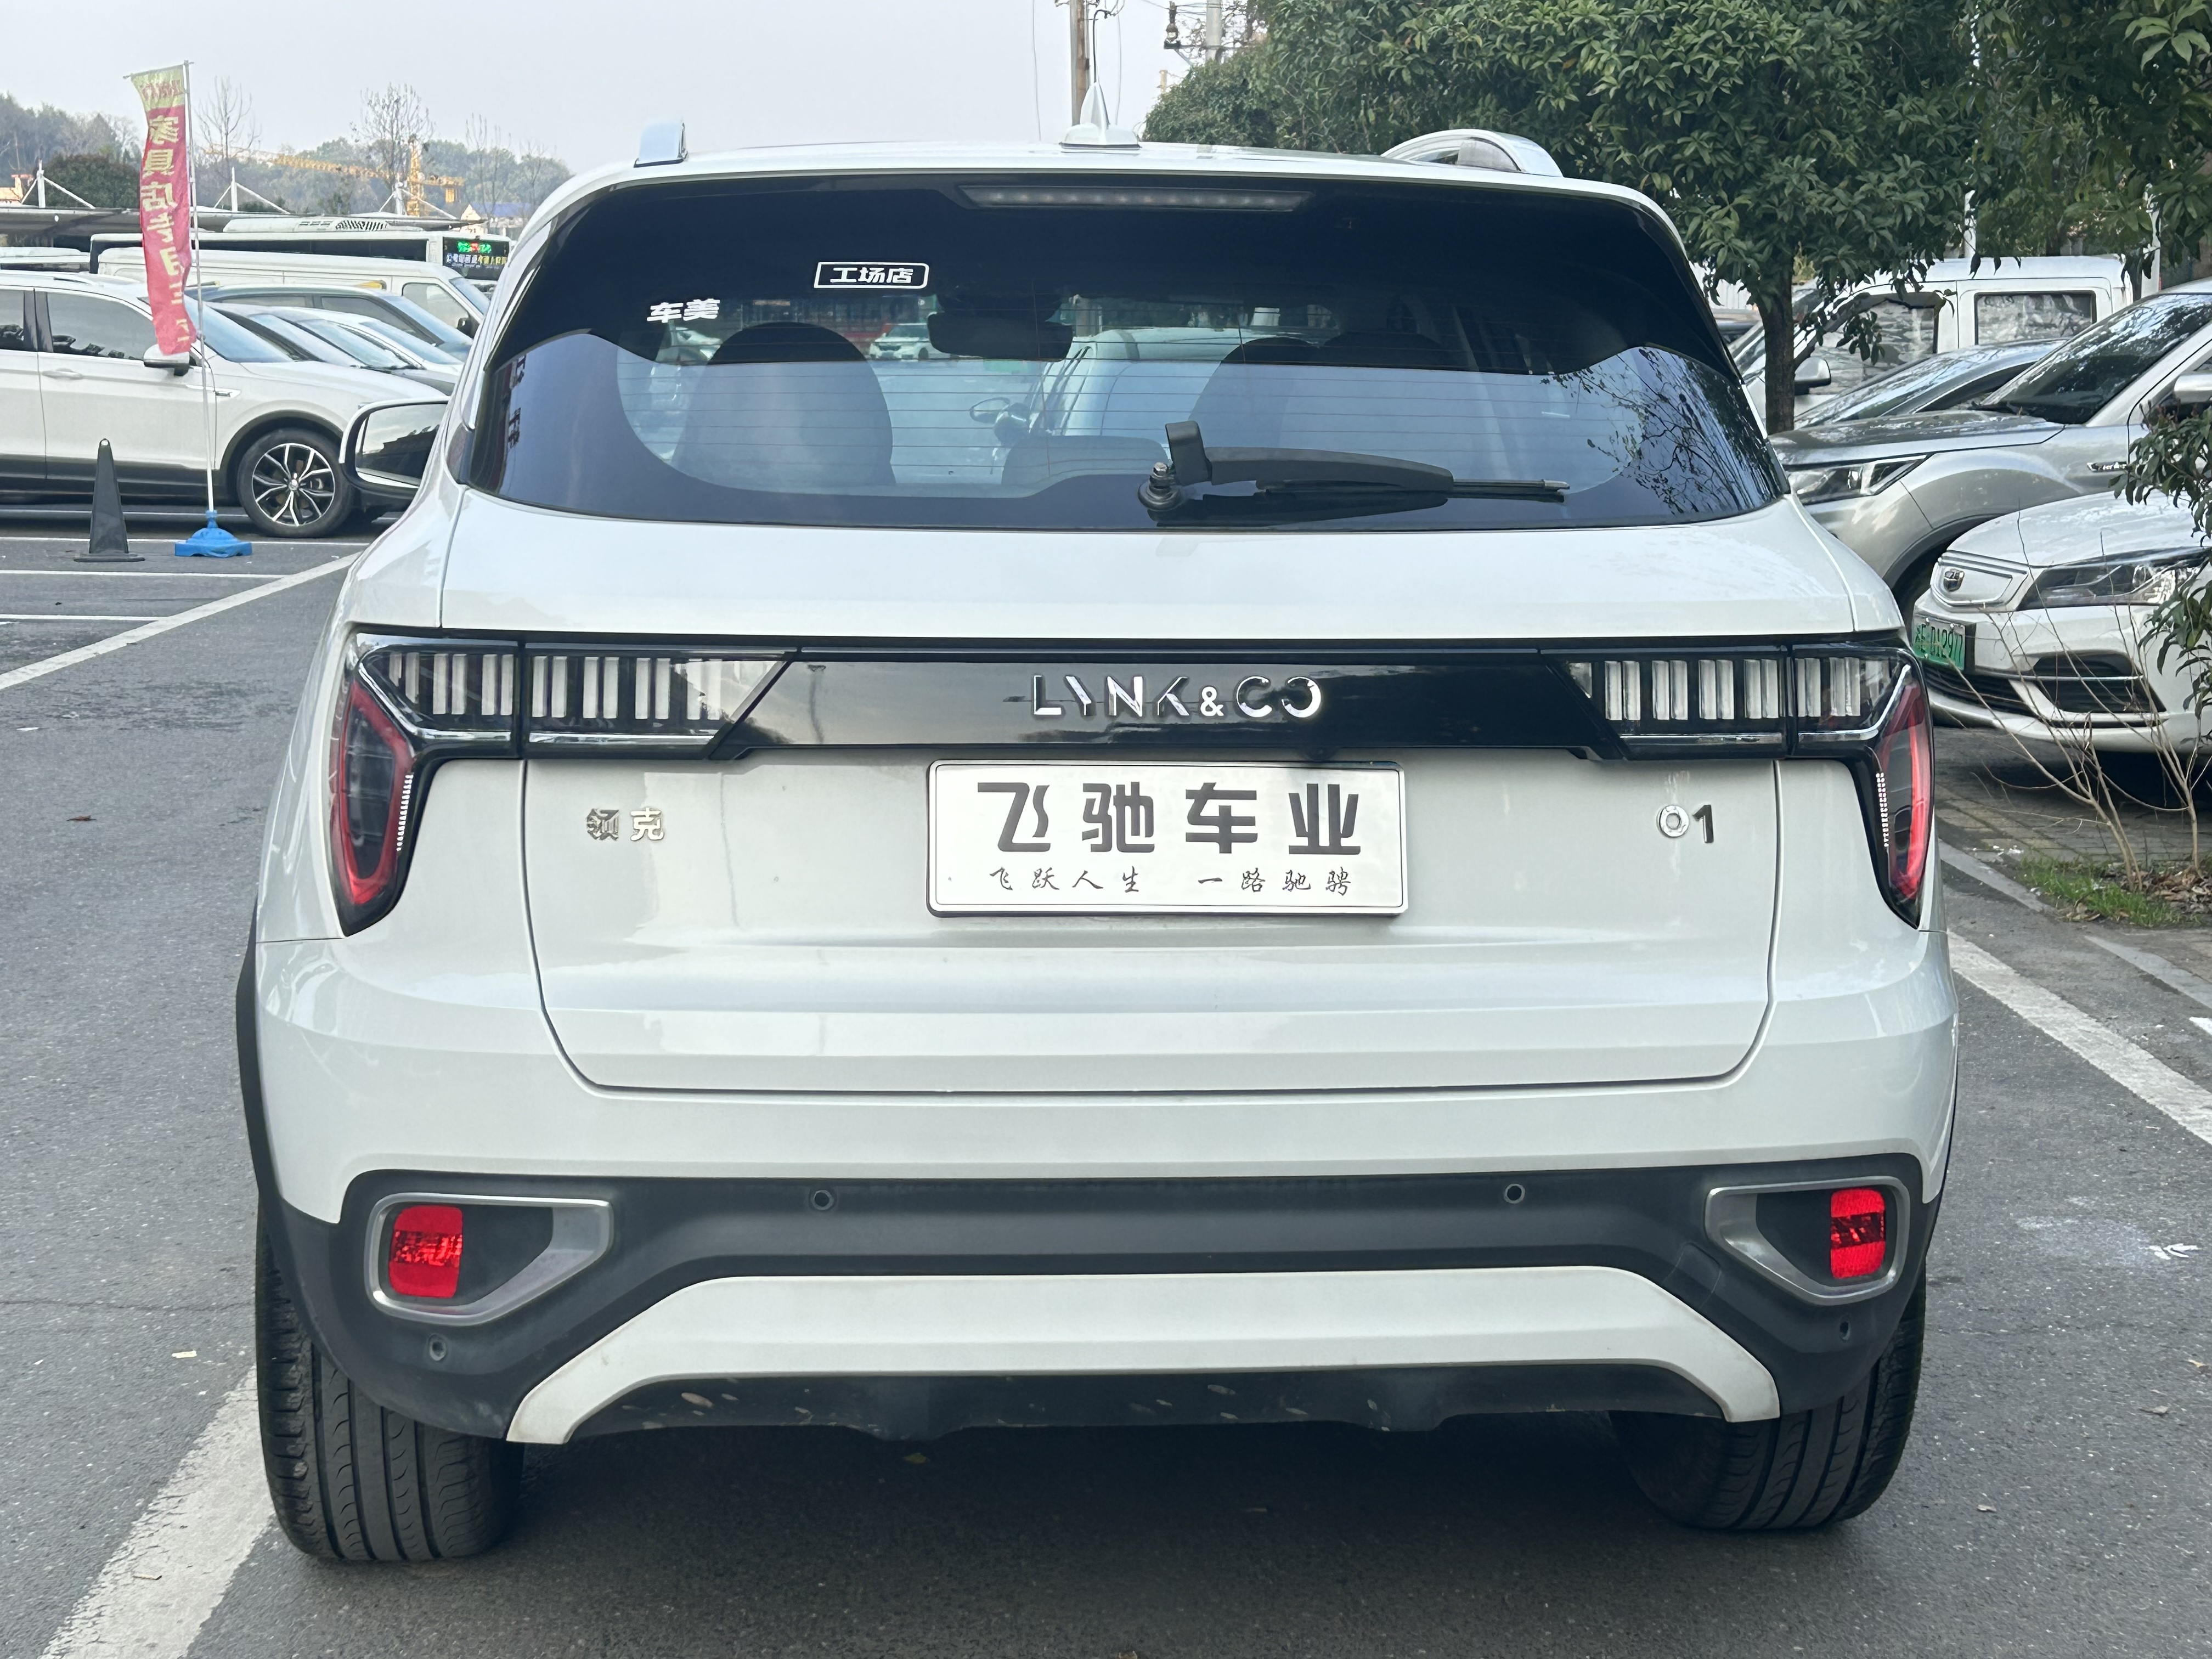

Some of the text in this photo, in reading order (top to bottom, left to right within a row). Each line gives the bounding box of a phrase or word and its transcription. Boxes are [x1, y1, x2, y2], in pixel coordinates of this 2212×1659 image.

[830, 267, 913, 283] 工场店
[647, 298, 720, 323] 车美
[585, 807, 664, 842] 领克
[977, 781, 1361, 855] 飞驰车业
[1656, 804, 1714, 843] 01
[989, 866, 1351, 896] 飞跃人生 一路驰骋
